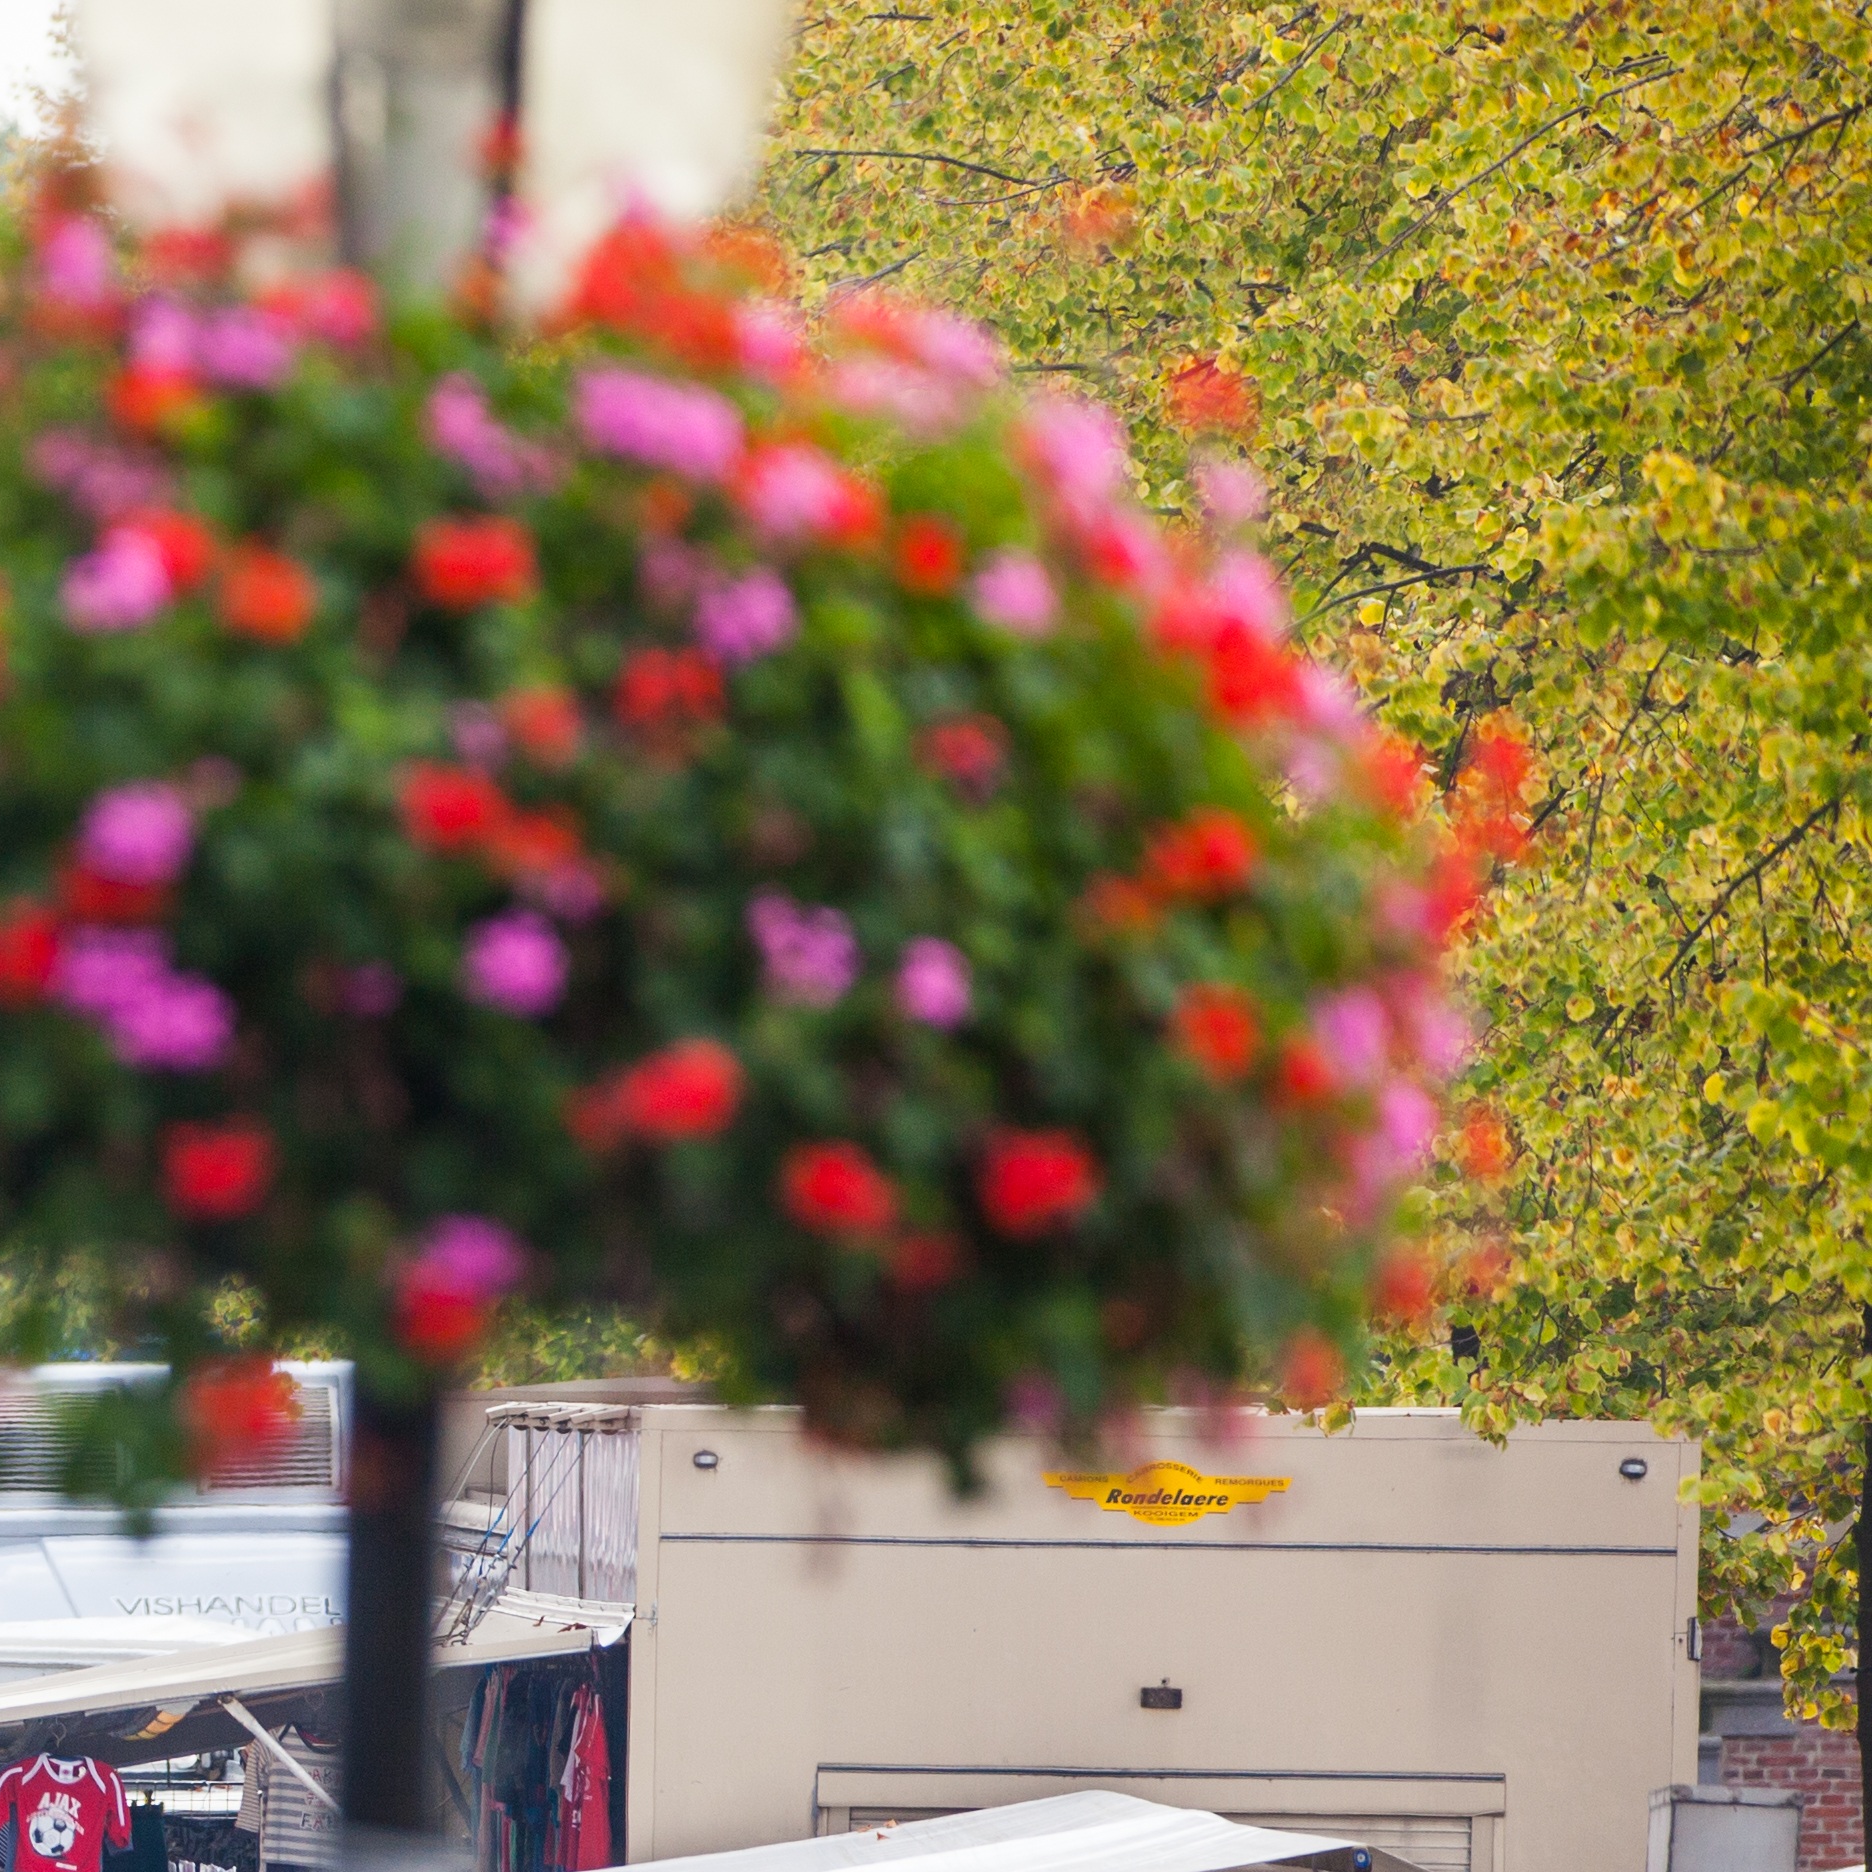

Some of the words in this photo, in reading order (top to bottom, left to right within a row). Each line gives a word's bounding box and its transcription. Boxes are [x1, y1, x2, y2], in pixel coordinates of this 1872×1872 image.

[1105, 1487, 1229, 1507] Rondelaere
[1132, 1509, 1200, 1518] KOOIGEM
[114, 1596, 342, 1617] VISHANDEL
[37, 1792, 82, 1820] AJAX
